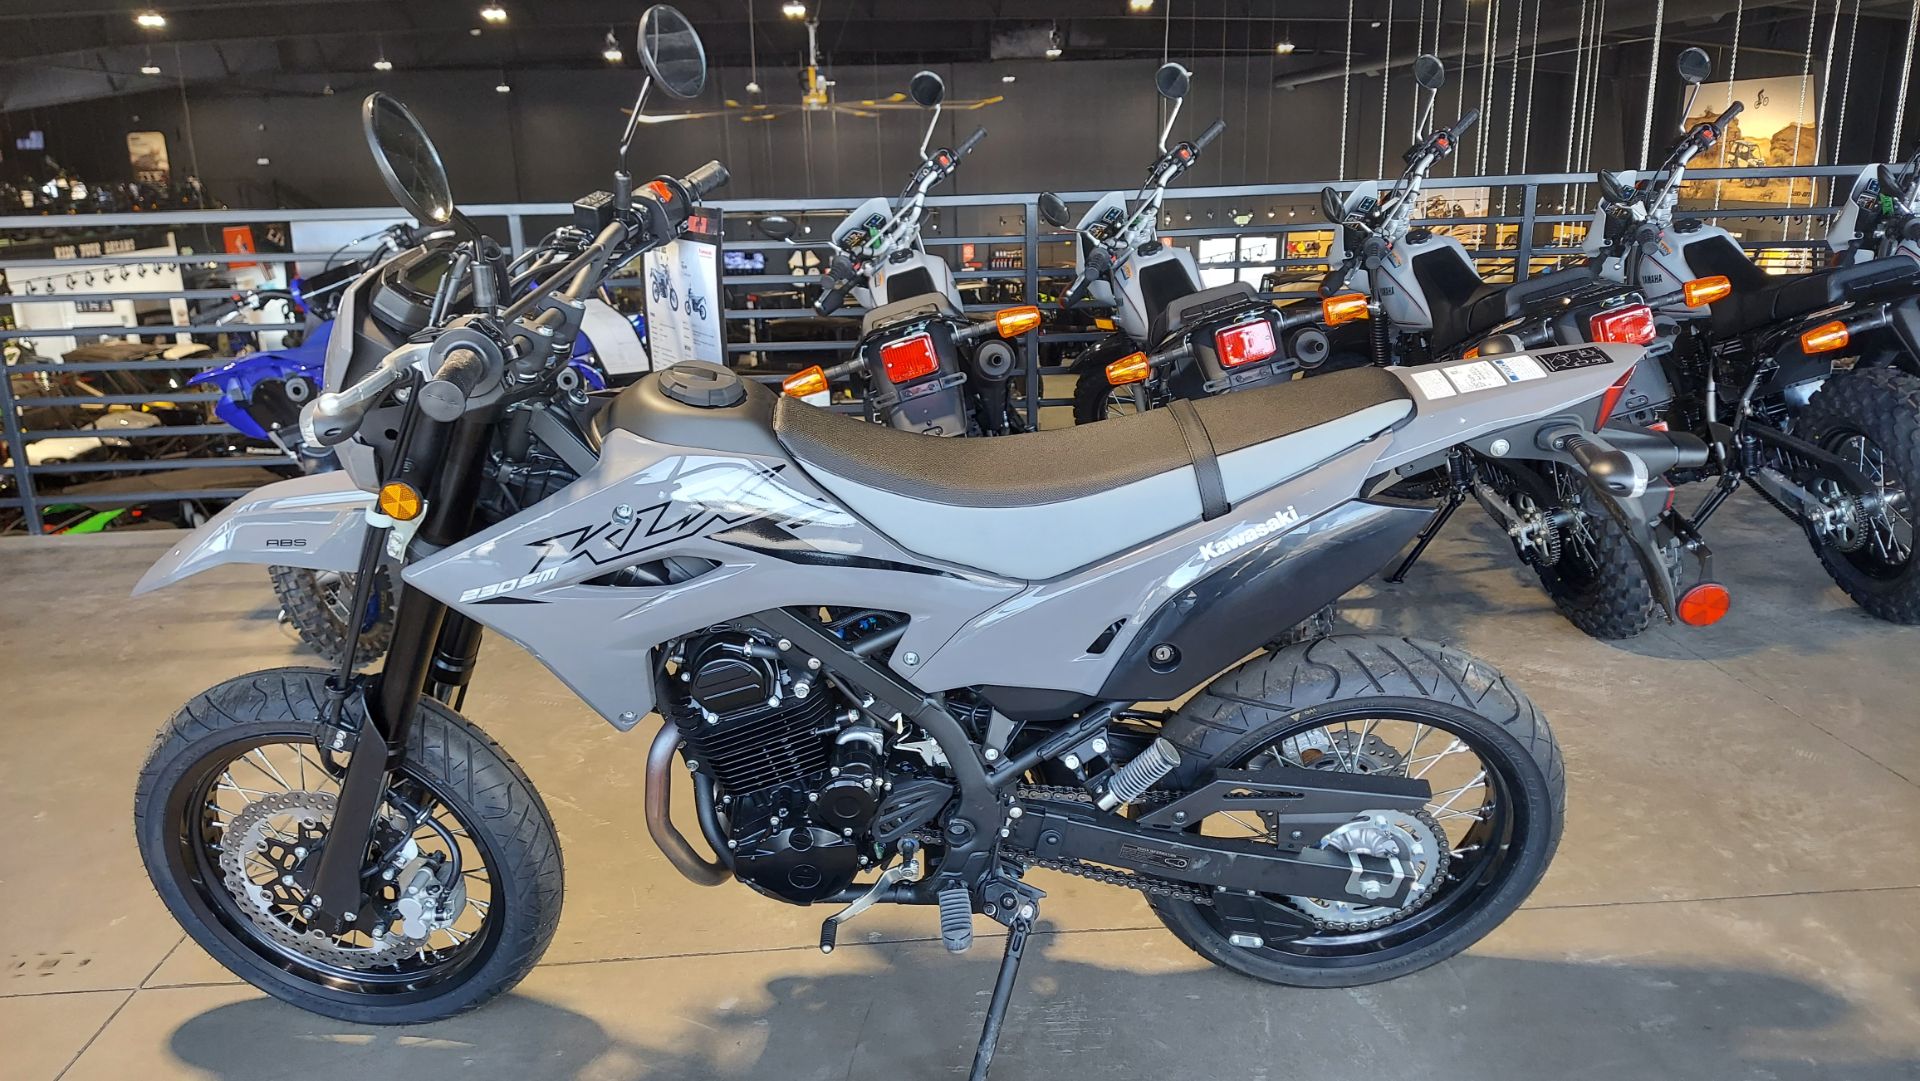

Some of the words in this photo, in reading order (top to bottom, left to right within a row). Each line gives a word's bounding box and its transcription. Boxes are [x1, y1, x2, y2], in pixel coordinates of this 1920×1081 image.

[1642, 274, 1663, 284] YAMAHA
[1199, 505, 1300, 561] Kawasaki
[266, 538, 307, 547] ABS
